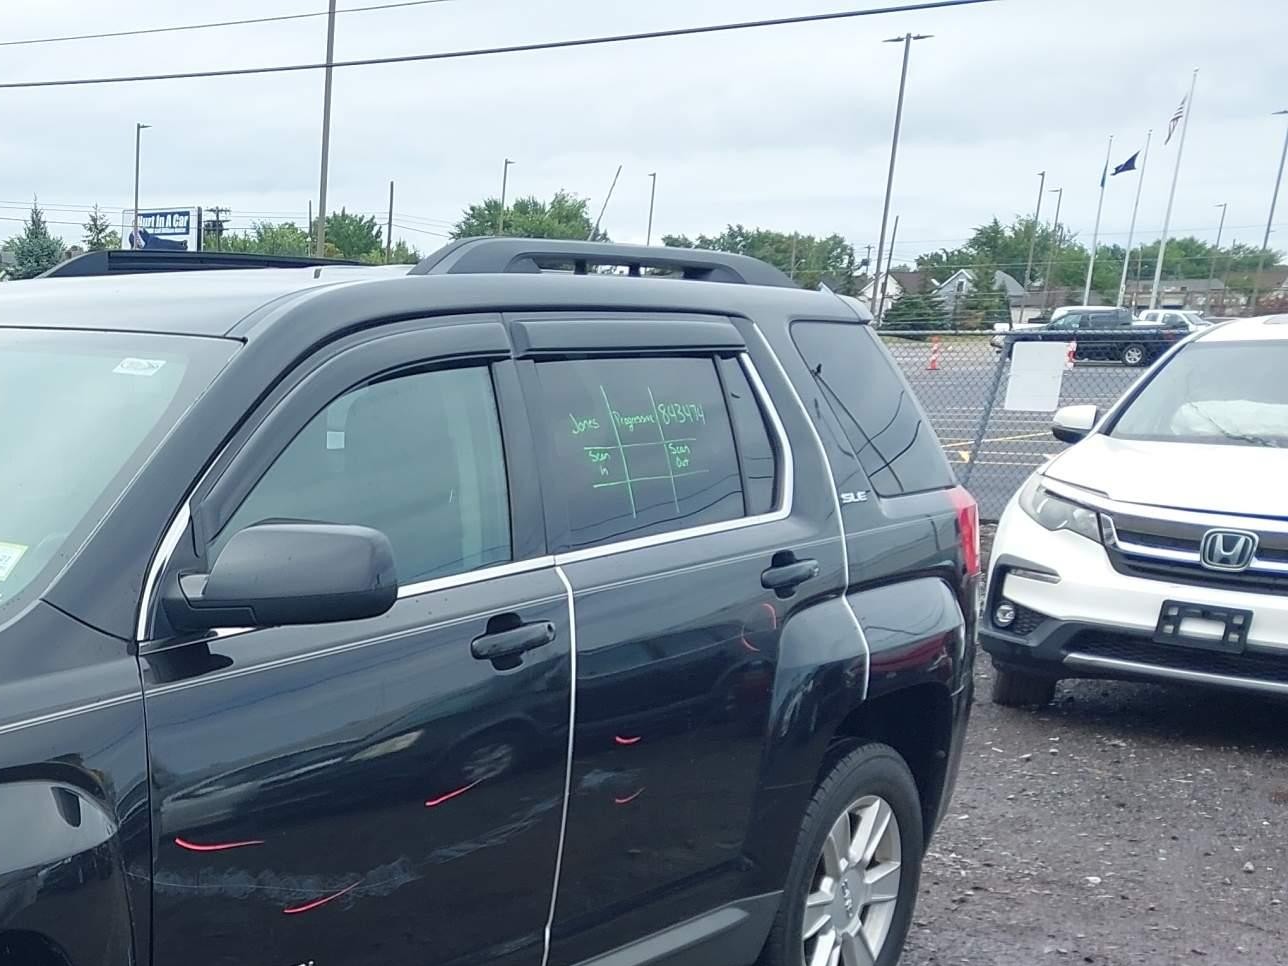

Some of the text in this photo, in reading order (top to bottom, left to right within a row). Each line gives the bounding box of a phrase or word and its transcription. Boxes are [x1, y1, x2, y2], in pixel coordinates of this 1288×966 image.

[137, 213, 189, 227] Hurt In A Car
[658, 403, 706, 425] 843474
[840, 491, 868, 503] SLE
